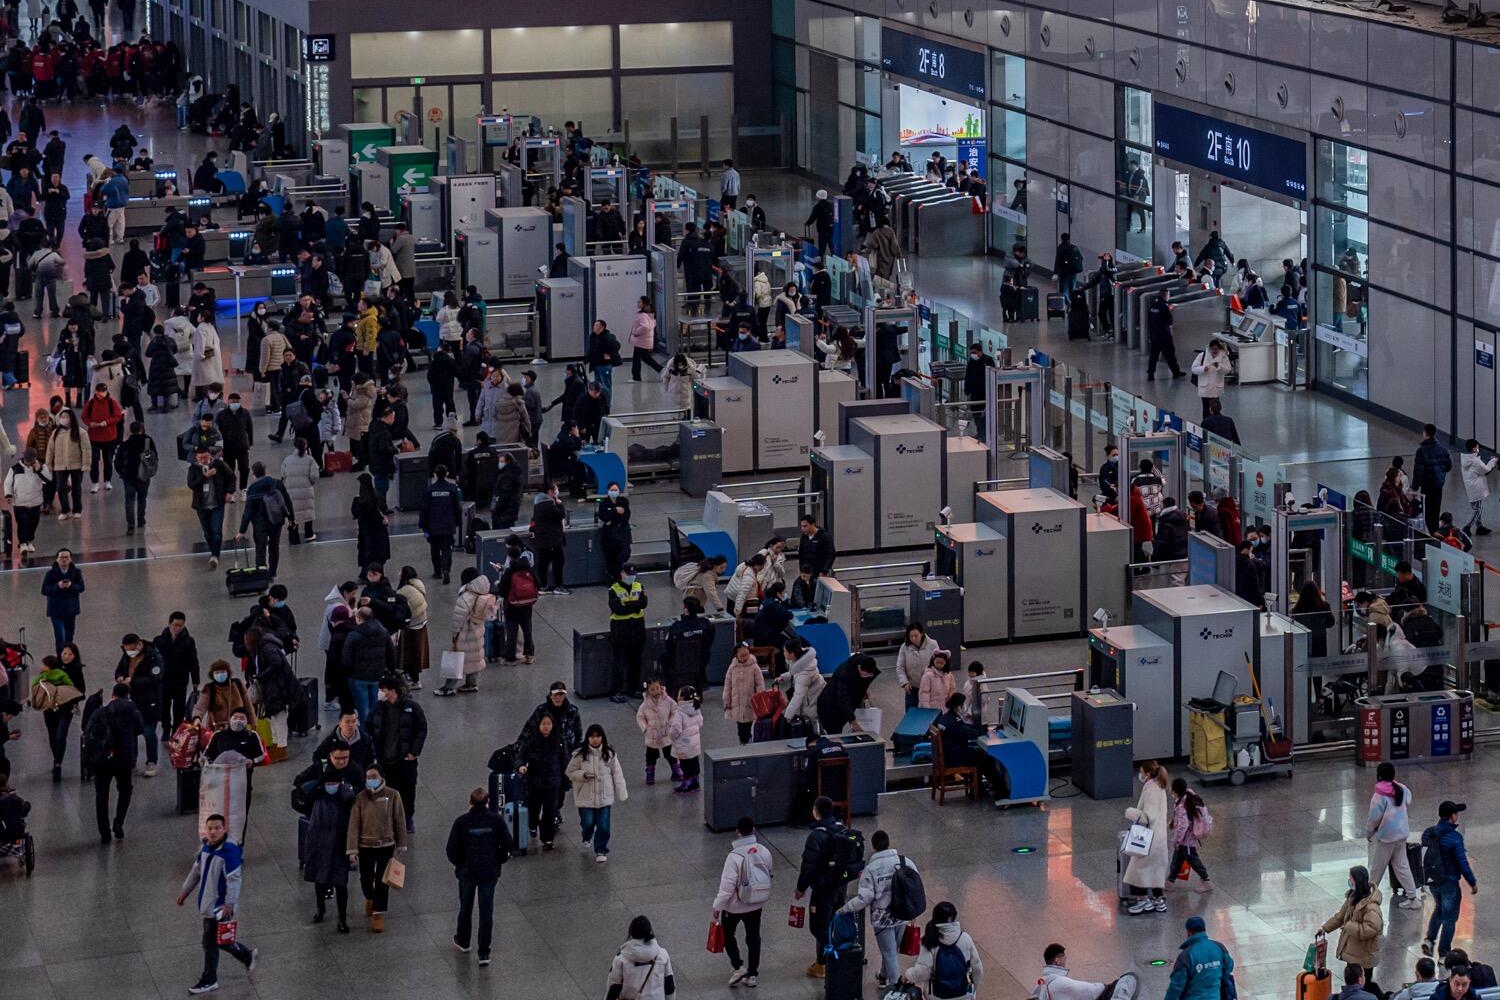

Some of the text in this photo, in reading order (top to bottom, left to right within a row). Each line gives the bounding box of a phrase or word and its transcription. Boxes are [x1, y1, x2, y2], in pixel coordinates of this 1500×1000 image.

[919, 48, 930, 73] 2F
[939, 53, 945, 78] 8
[1207, 130, 1250, 171] 2F 南 10
[1436, 578, 1452, 600] 关闭
